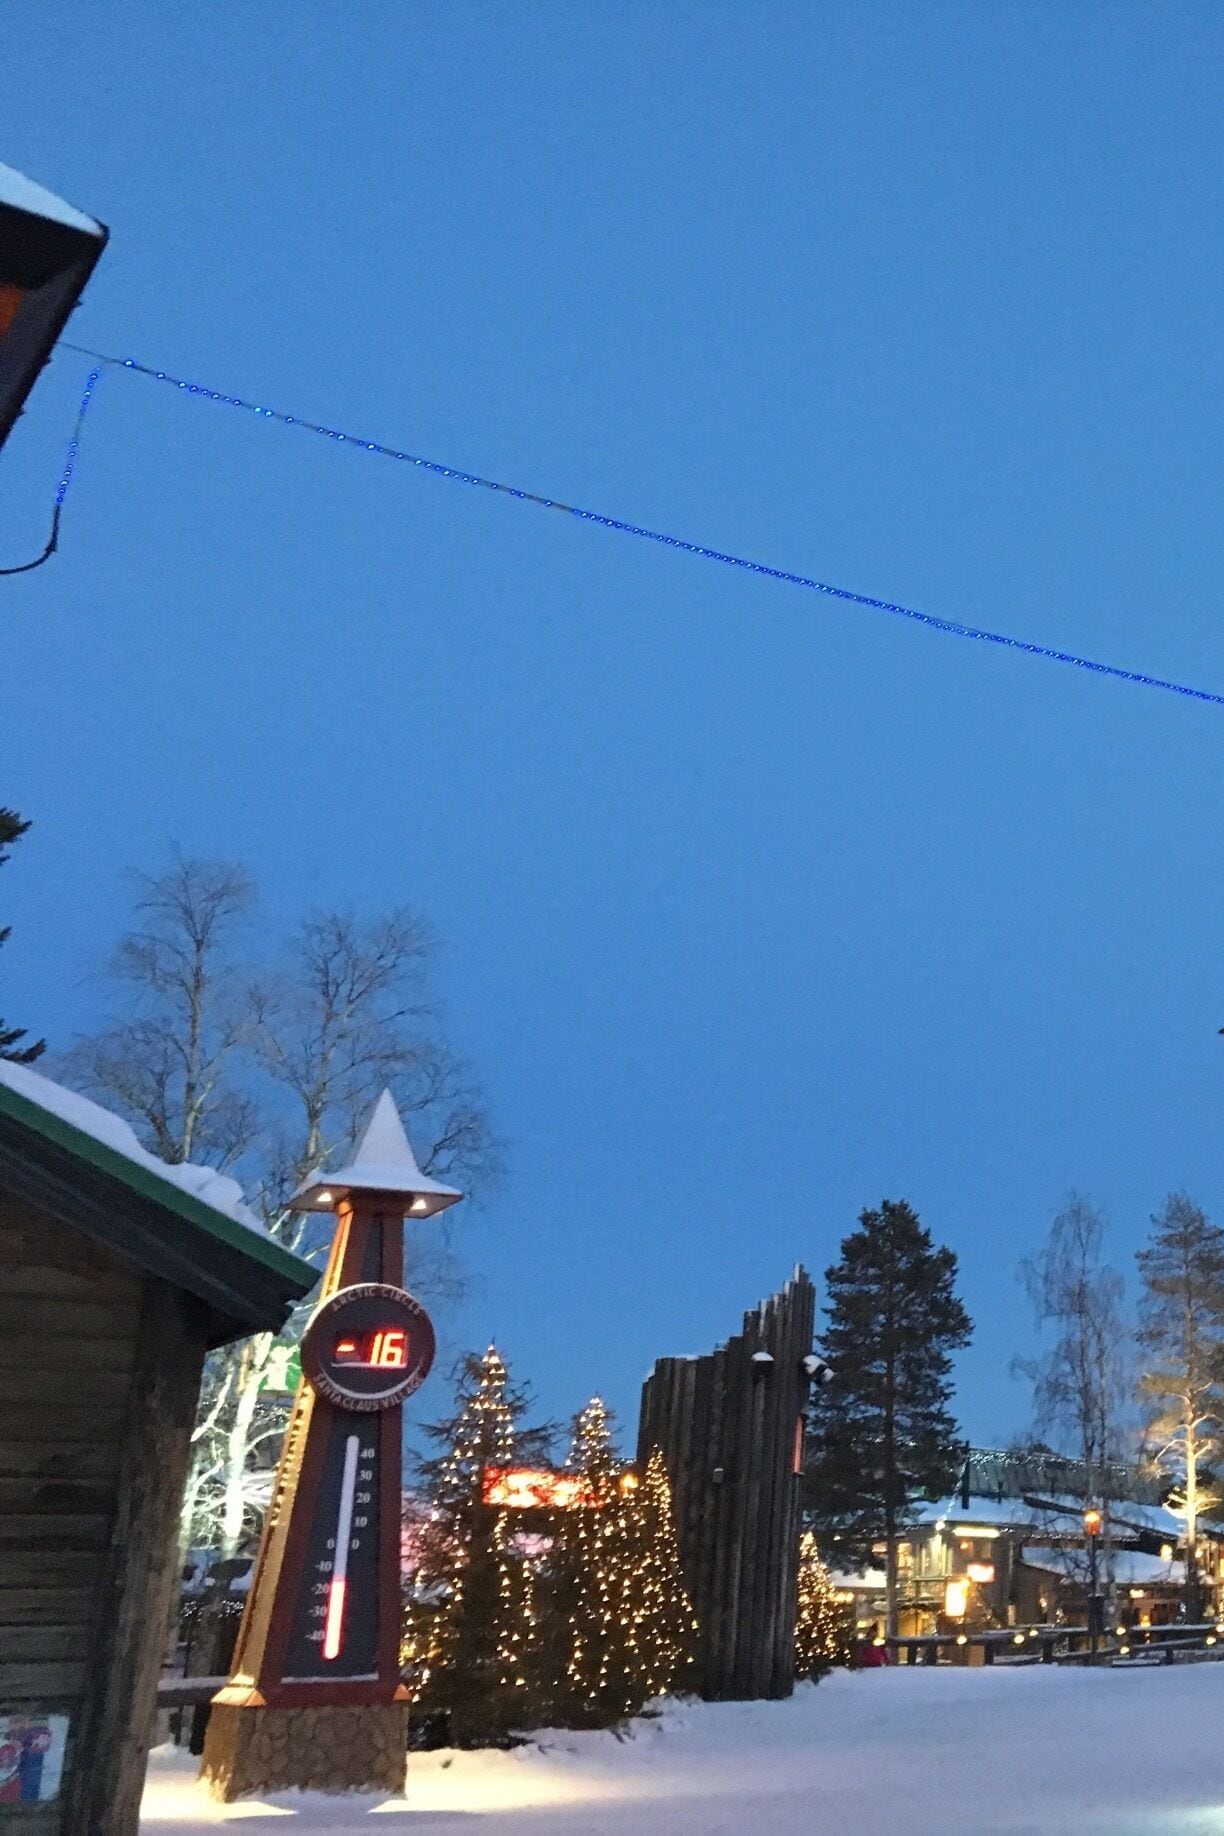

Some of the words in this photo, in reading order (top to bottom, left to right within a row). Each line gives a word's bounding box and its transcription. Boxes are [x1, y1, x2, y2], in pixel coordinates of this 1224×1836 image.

[332, 1287, 376, 1311] ARCTIC
[382, 1286, 422, 1315] CIRCLE
[316, 1374, 344, 1407] SANTA
[343, 1397, 379, 1412] CLAUS
[361, 1448, 375, 1459] 40
[359, 1470, 373, 1481] 30
[356, 1492, 371, 1504] 20
[354, 1516, 368, 1527] 10
[327, 1538, 335, 1549] 0
[352, 1539, 360, 1550] 0
[315, 1560, 332, 1572] -10
